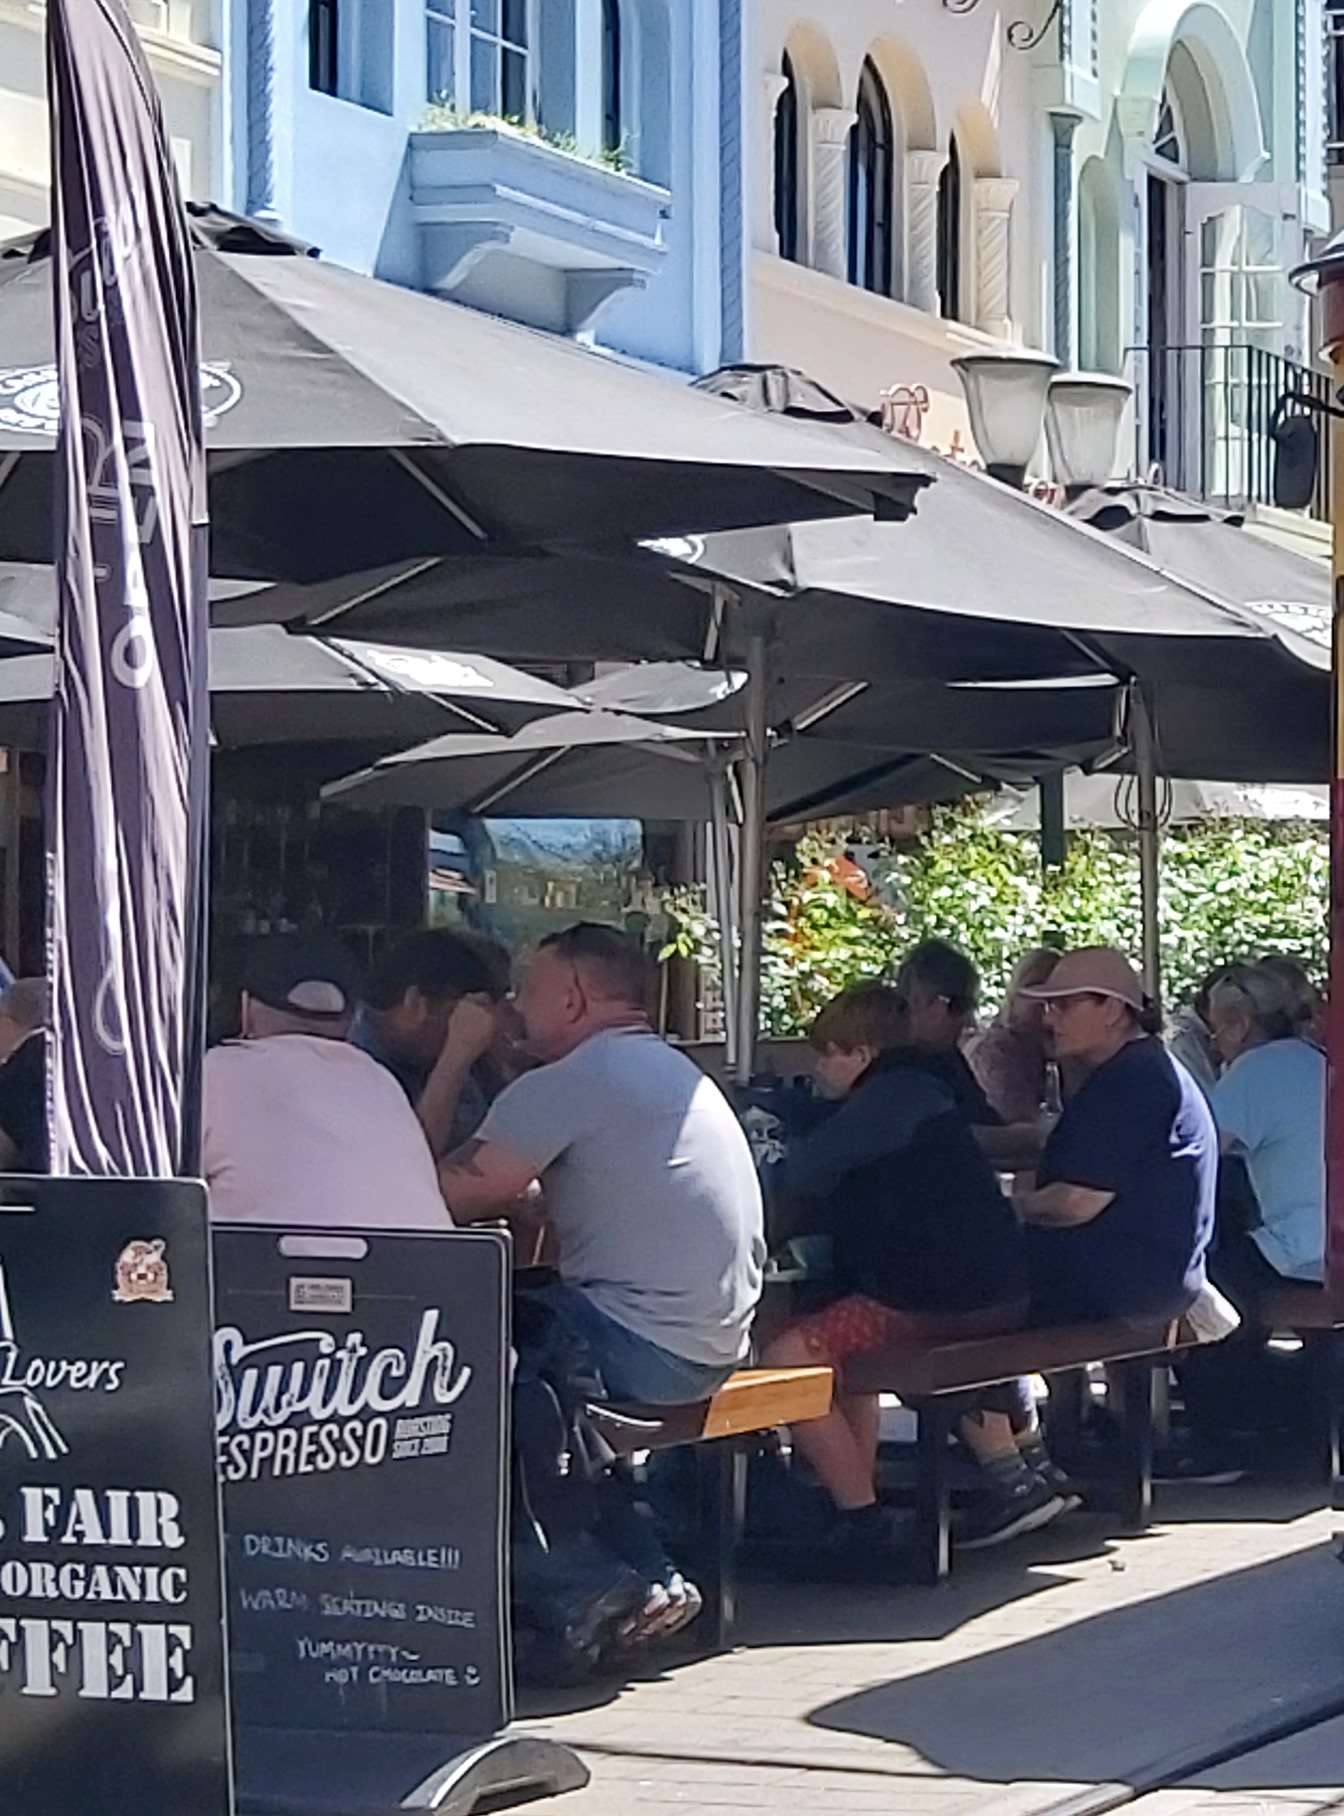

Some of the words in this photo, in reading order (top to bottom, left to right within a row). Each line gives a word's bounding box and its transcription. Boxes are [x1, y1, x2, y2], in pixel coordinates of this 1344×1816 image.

[1, 1350, 125, 1391] Lovers
[213, 1308, 472, 1432] Switch
[216, 1417, 388, 1481] ESPRESSO
[21, 1486, 186, 1548] FAIR
[244, 1534, 330, 1562] DRINKS
[1, 1560, 188, 1604] ORGANIC
[0, 1617, 194, 1702] FEE
